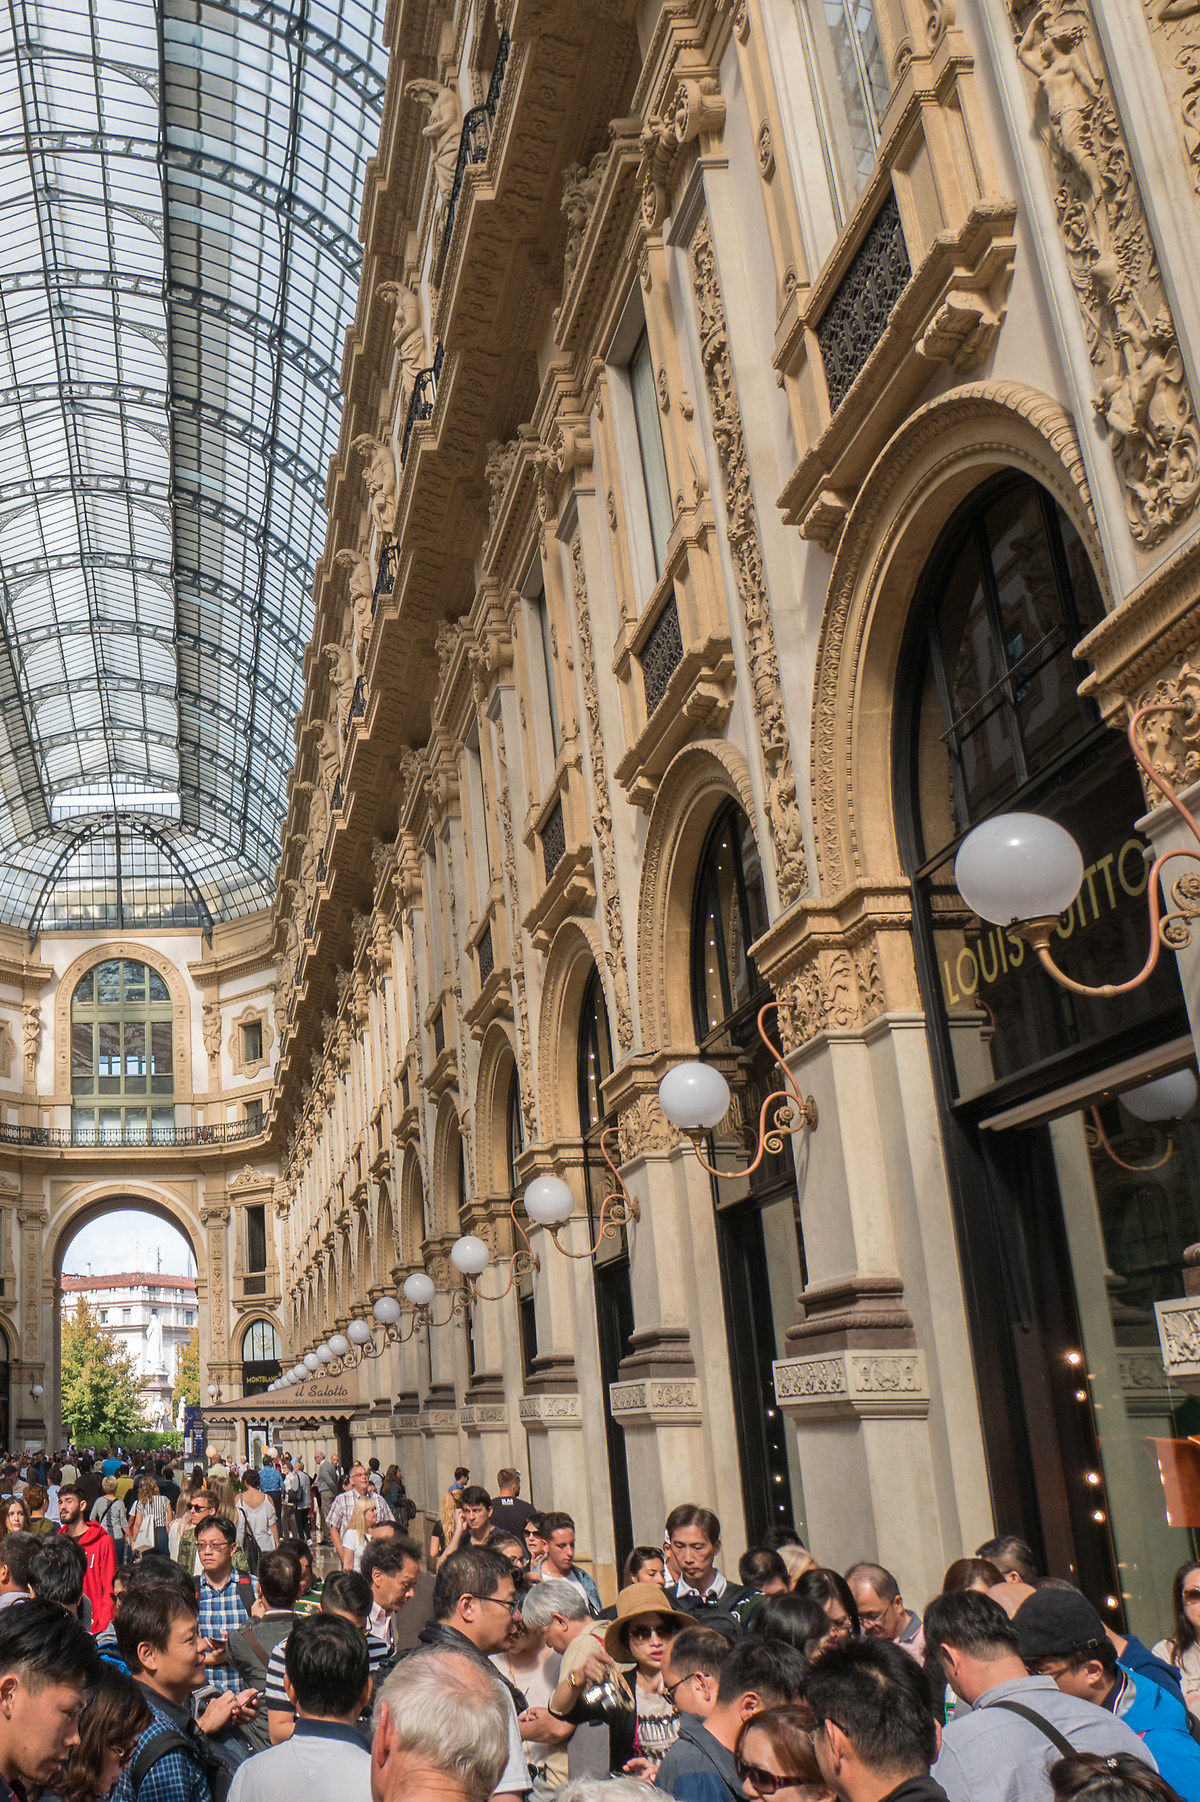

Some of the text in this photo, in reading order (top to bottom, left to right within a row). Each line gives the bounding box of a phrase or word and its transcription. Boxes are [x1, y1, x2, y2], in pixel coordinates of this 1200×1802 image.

[944, 926, 1024, 1005] LOUIS
[295, 1384, 349, 1397] il Salotto
